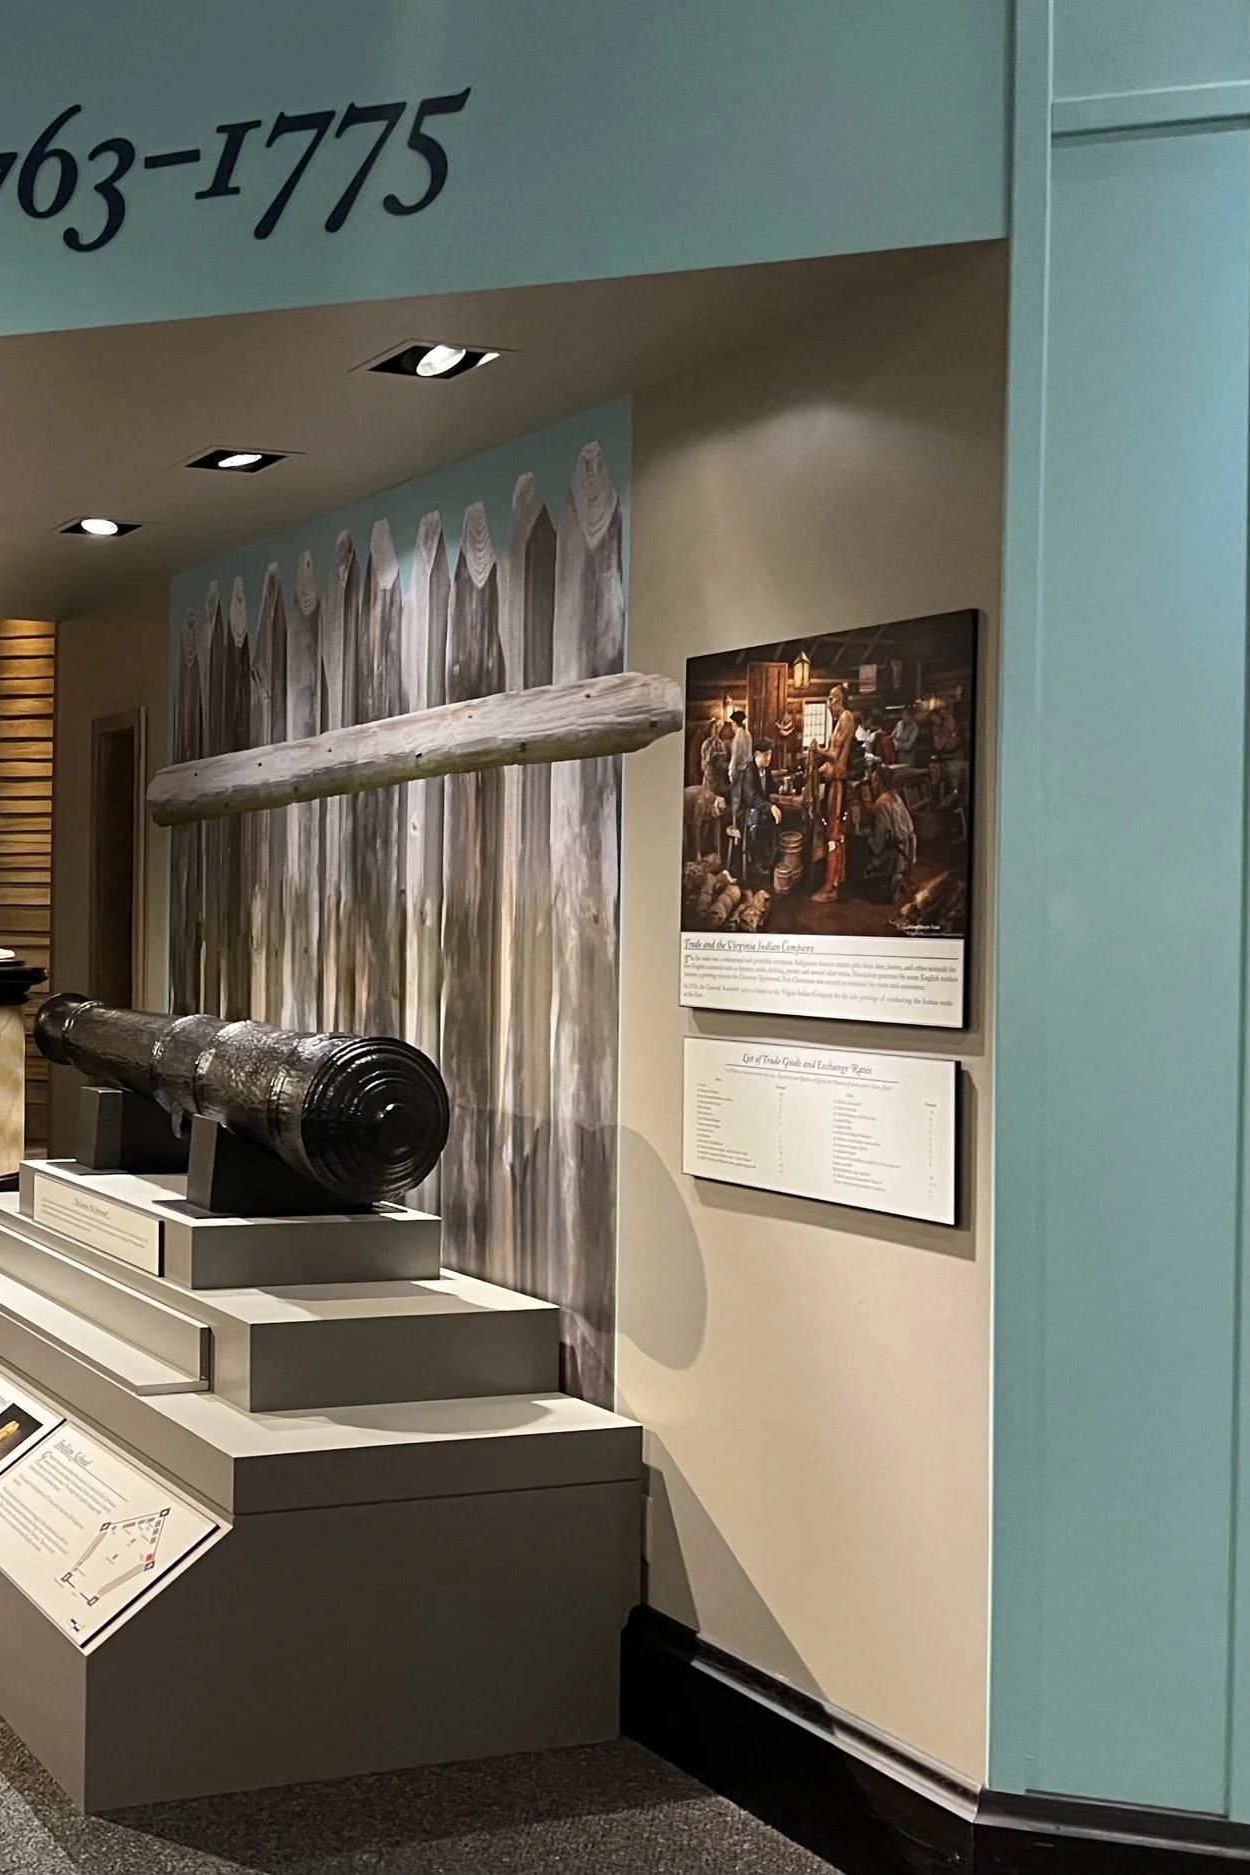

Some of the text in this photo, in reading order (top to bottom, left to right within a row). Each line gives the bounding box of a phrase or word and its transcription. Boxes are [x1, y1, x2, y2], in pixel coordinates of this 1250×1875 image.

[685, 938, 815, 955] Trade and the Virginia Indian Company
[761, 1055, 781, 1065] Trade
[782, 1056, 802, 1068] Goods
[803, 1059, 816, 1069] and
[817, 1060, 849, 1074] Exchange
[850, 1063, 872, 1076] Rates
